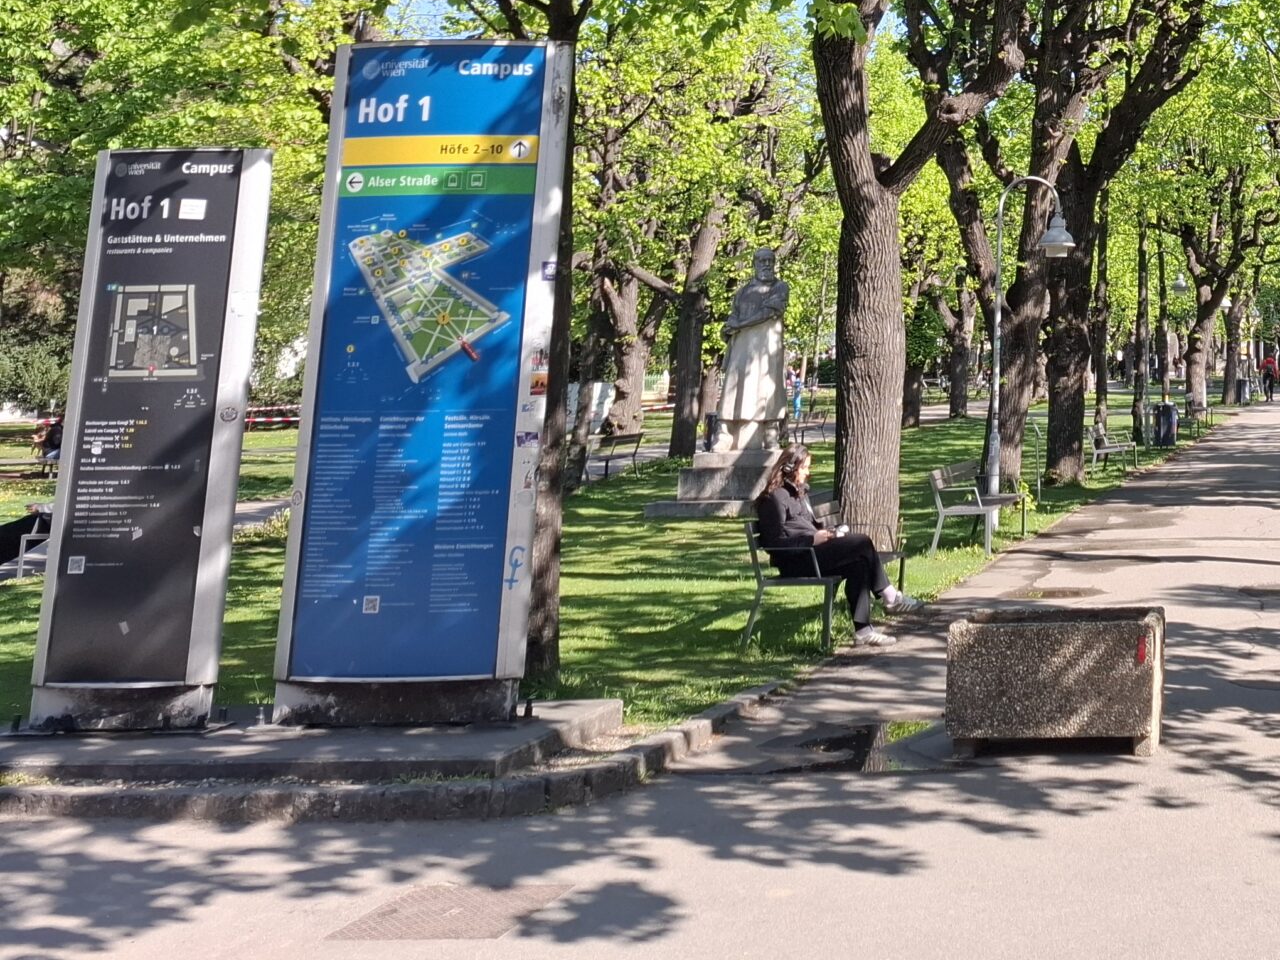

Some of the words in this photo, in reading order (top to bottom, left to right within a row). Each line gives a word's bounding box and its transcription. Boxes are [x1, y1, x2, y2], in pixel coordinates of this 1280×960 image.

[381, 58, 429, 70] universität
[458, 59, 534, 80] Campus
[381, 67, 406, 77] wien
[358, 94, 409, 123] Hof
[418, 96, 432, 121] 1
[440, 143, 469, 155] Höfe
[127, 161, 162, 171] universität
[128, 168, 145, 176] wien
[181, 161, 235, 176] Campus
[368, 176, 396, 188] Alser
[400, 175, 438, 187] Straße
[110, 195, 152, 220] Hof
[160, 197, 171, 219] 1
[107, 234, 153, 245] Gaststätten
[155, 233, 162, 243] &
[163, 232, 227, 243] Unternehmen
